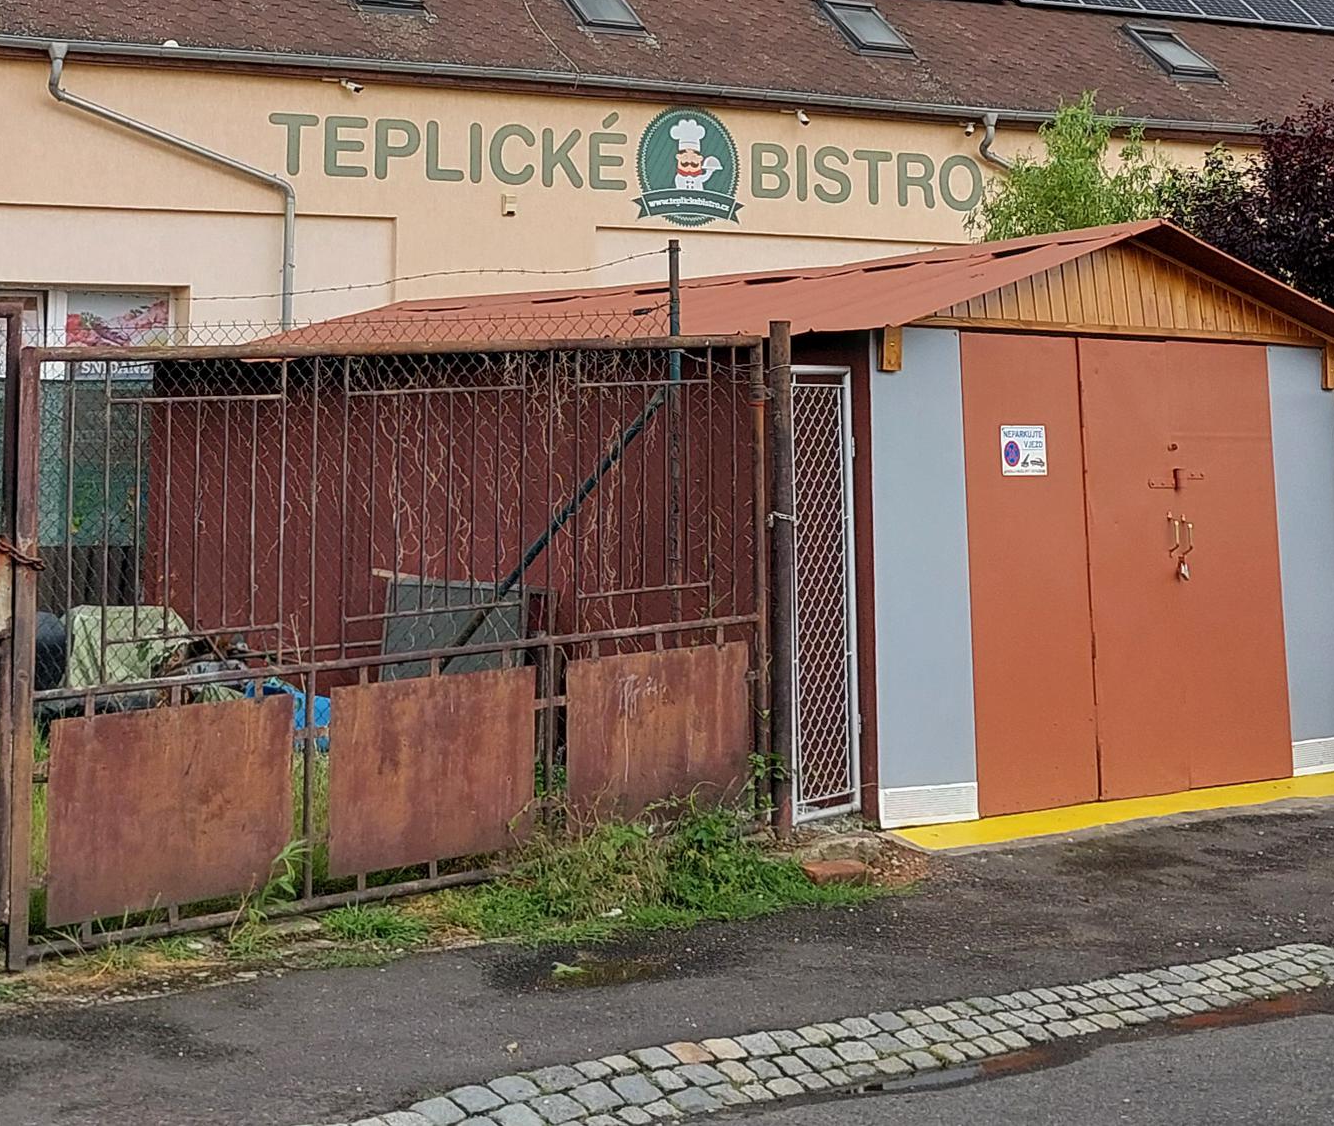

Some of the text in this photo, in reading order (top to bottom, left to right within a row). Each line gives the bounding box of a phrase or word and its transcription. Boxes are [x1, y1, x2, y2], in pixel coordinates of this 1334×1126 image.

[268, 112, 984, 212] TEPLICKÉ BISTRO
[1003, 430, 1043, 439] NEPARKUJTE
